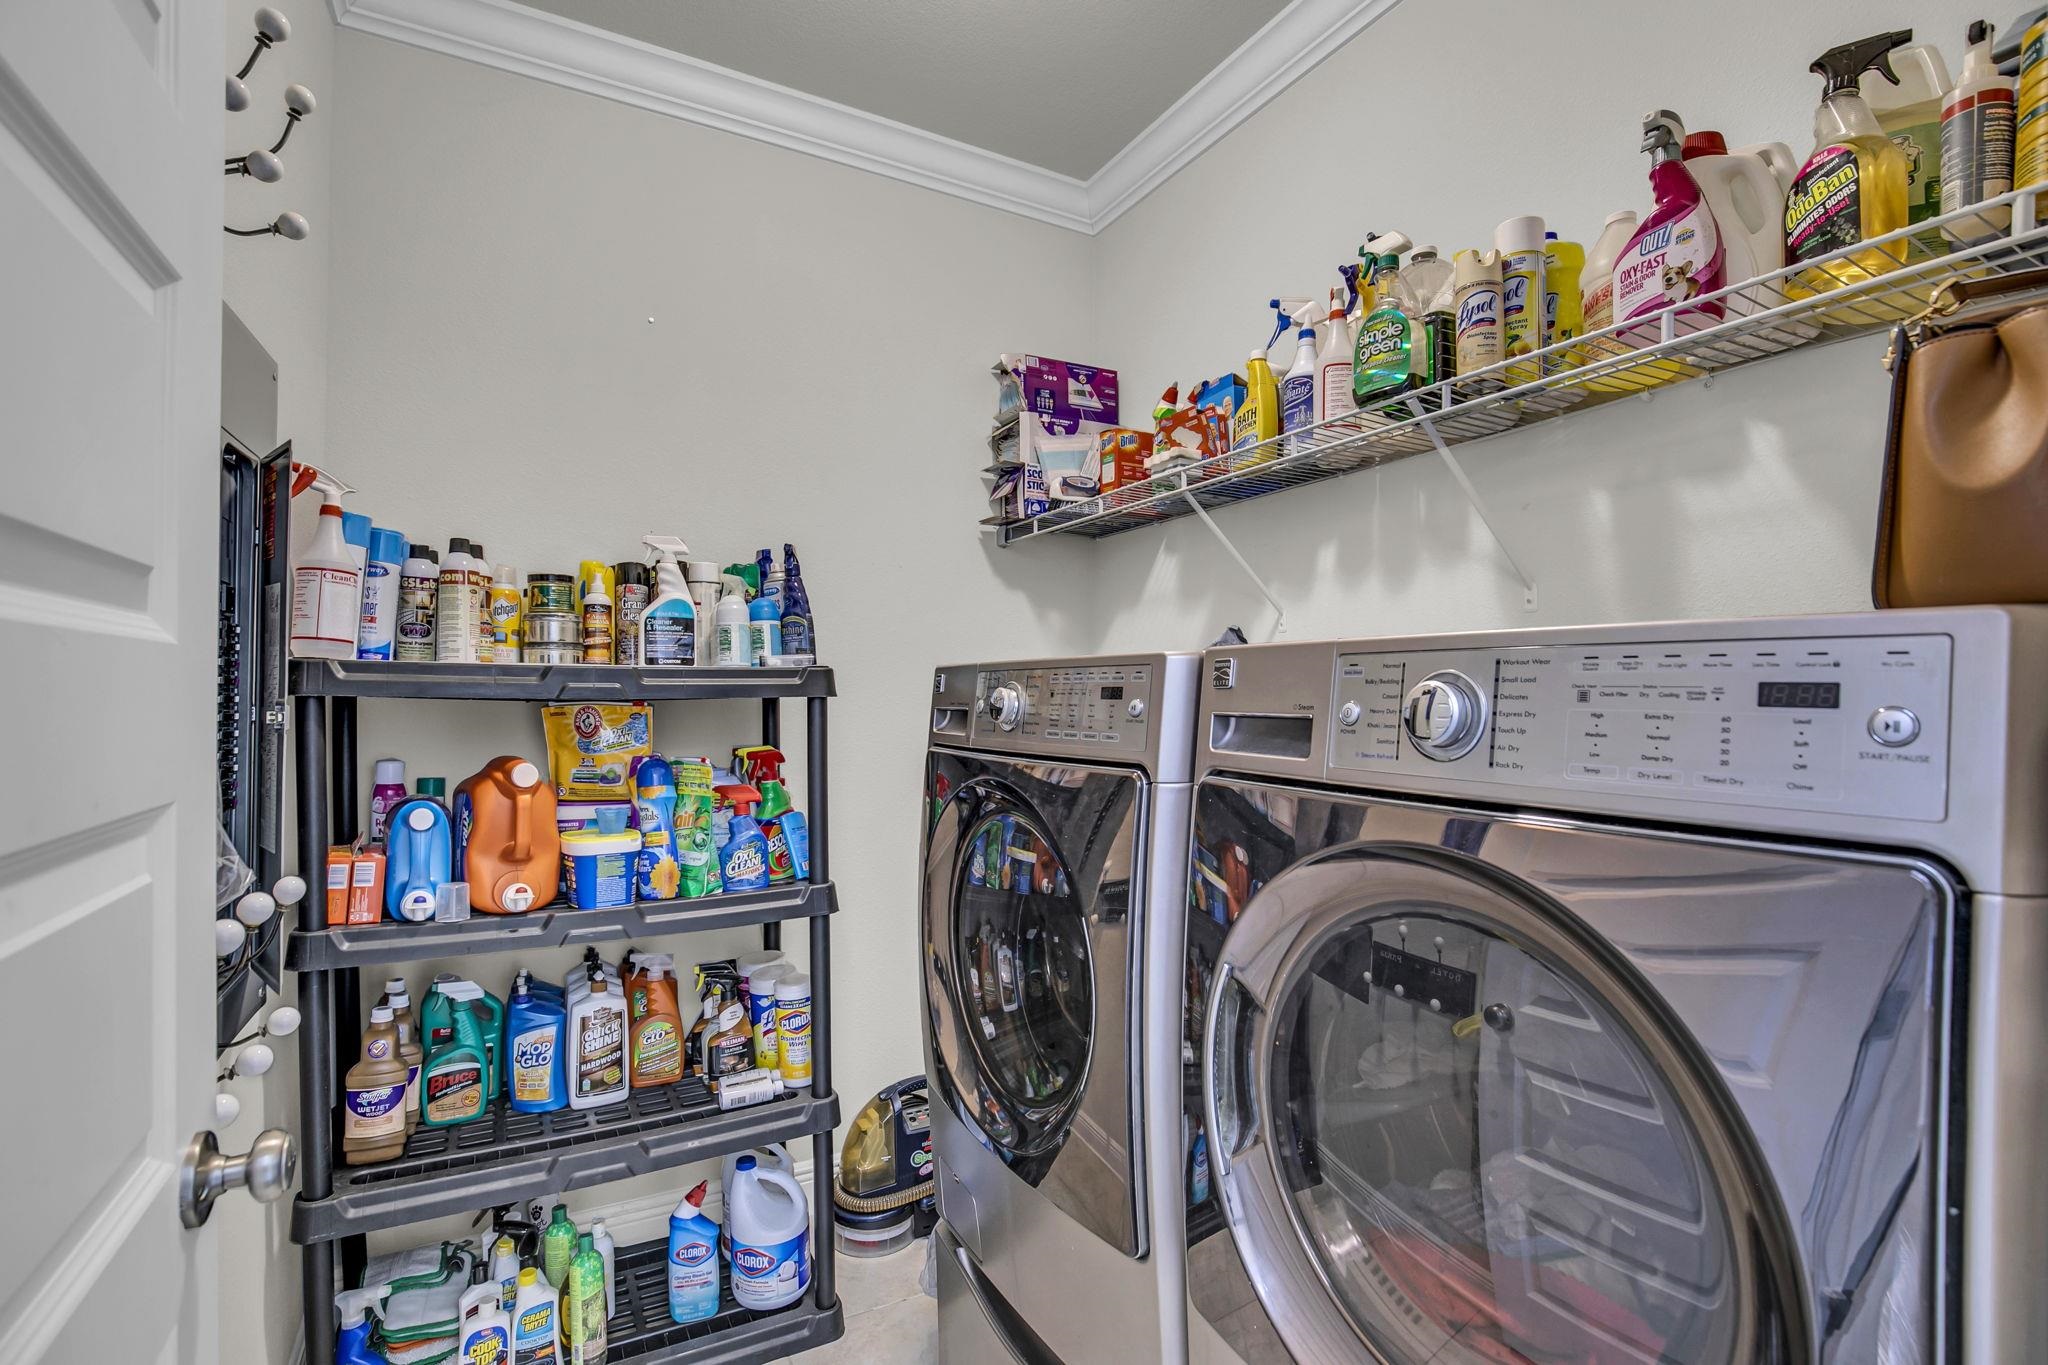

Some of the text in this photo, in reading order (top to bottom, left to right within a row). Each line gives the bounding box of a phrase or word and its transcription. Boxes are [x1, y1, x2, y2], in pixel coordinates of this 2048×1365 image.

[1786, 165, 1855, 231] OdoBan
[1787, 205, 1825, 246] ELIMINATES
[1825, 182, 1857, 209] ODORS
[1641, 221, 1674, 255] OUT!
[1620, 252, 1667, 284] OXY-FAST
[1620, 280, 1634, 292] STAIN
[1639, 269, 1656, 282] ODOR
[1620, 283, 1644, 300] REMOVER
[1457, 295, 1497, 330] Lysol
[1359, 321, 1404, 348] simple
[1509, 323, 1528, 332] Spray
[1359, 337, 1401, 364] green
[1237, 406, 1257, 428] BATH
[1120, 434, 1138, 448] Brillo
[1524, 711, 1536, 719] Dry
[1662, 713, 1675, 721] Dry
[1516, 727, 1527, 735] Up
[1720, 737, 1731, 745] 40
[1508, 744, 1520, 753] Dry
[1641, 754, 1673, 763] Damp Dry
[1719, 759, 1730, 767] 20
[1512, 762, 1524, 770] Dry
[1583, 766, 1600, 774] Temp
[1637, 771, 1672, 780] Dry Level
[1702, 775, 1744, 787] Timed Dry
[1786, 782, 1814, 792] Chime
[733, 850, 754, 862] OXI
[727, 855, 760, 874] CLEAN
[781, 1013, 811, 1030] CLOROX
[584, 1021, 619, 1041] QUICK
[643, 1030, 665, 1045] GLO
[519, 1042, 551, 1055] MOP
[584, 1032, 620, 1053] SHINE
[721, 1036, 745, 1047] WEIMAN
[521, 1054, 551, 1068] GLO
[581, 1051, 622, 1071] HARDWOOD
[429, 1070, 478, 1095] Bruce
[357, 1088, 393, 1104] Swiffer
[680, 1247, 707, 1259] CLOROX
[737, 1252, 769, 1269] CLOROX
[521, 1308, 551, 1325] CERAMA
[524, 1318, 548, 1332] BRYTE
[520, 1335, 549, 1346] COOKTOP
